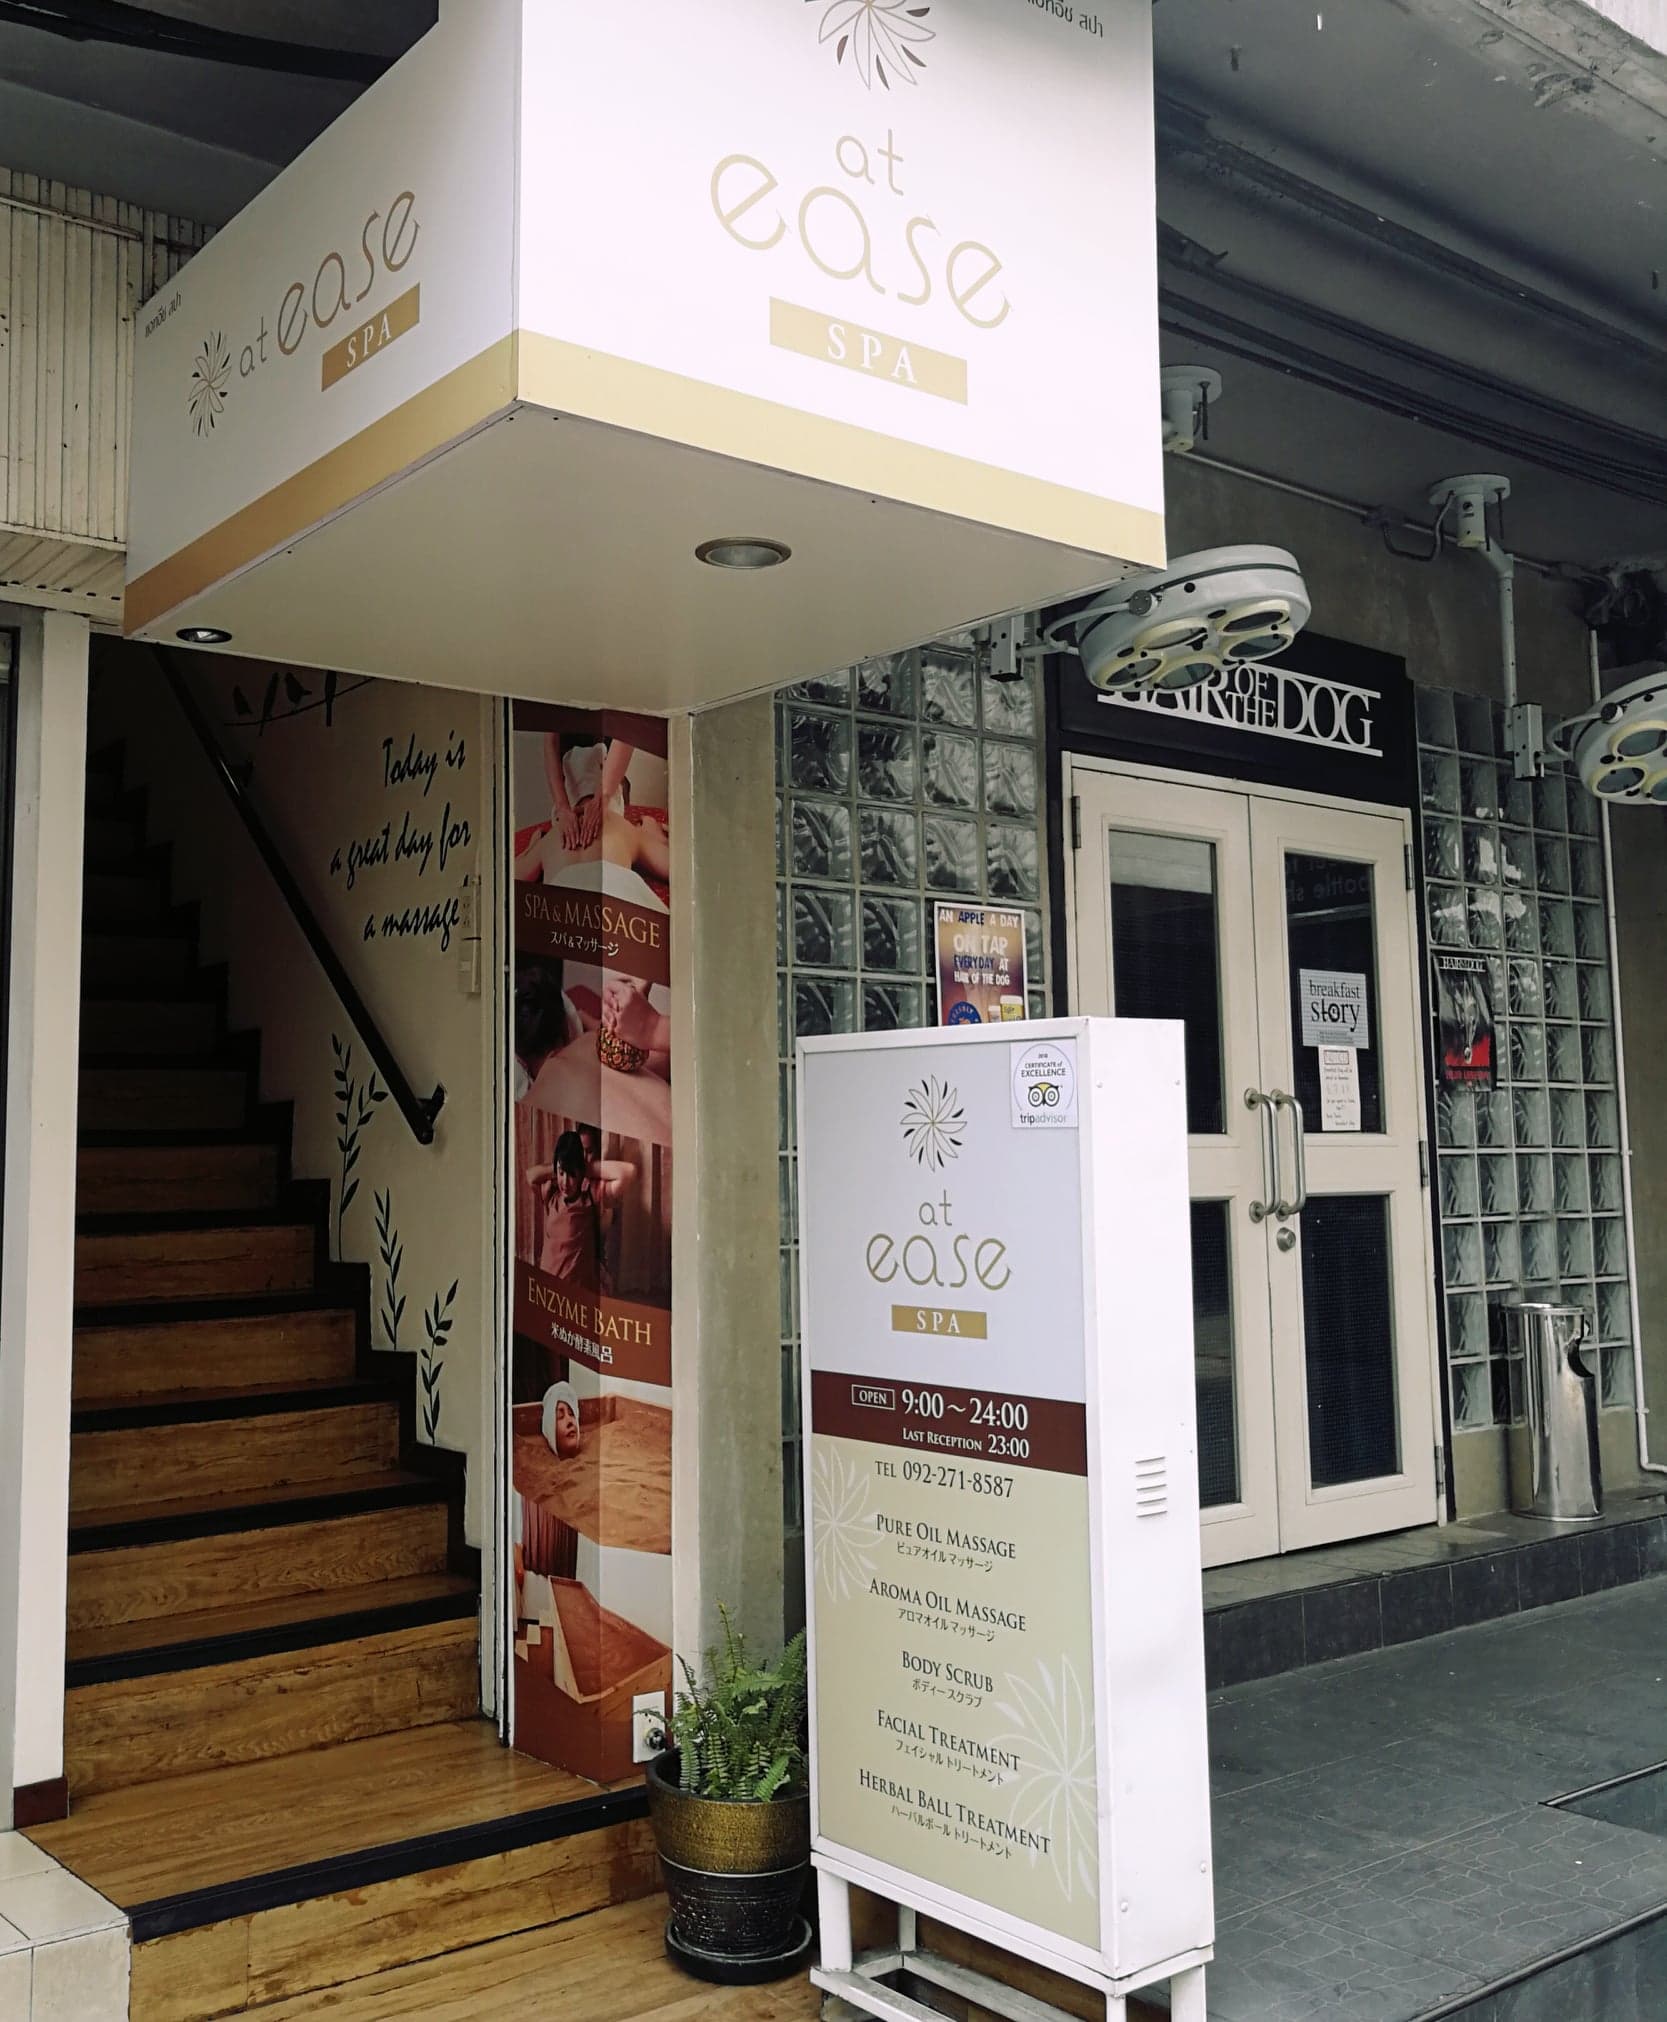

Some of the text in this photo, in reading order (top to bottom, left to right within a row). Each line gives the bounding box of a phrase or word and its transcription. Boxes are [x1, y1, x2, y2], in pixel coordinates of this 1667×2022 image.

[1080, 14, 1103, 38] สปา
[836, 128, 904, 196] at
[711, 154, 1012, 329] ease
[239, 191, 420, 377] at ease
[346, 312, 392, 369] SPA
[827, 322, 917, 384] SPA
[1234, 664, 1269, 696] OF
[1226, 691, 1276, 728] THE
[1277, 674, 1374, 747] DOG
[382, 730, 466, 797] Today is
[330, 802, 471, 890] a great day for
[363, 898, 460, 952] a massage
[524, 893, 550, 921] SPA
[564, 901, 661, 949] MASSAGE
[939, 909, 1019, 928] AN APPLE A DAY
[953, 934, 1008, 955] ON TAP
[999, 958, 1009, 971] AT
[971, 972, 979, 984] OF
[995, 974, 1010, 986] DOG
[1309, 979, 1360, 999] breakfast
[1311, 998, 1360, 1032] story
[1021, 1068, 1066, 1077] EXCELLENCE
[1020, 1112, 1066, 1126] tripadvisor
[918, 1189, 952, 1226] at
[866, 1233, 1013, 1291] ease
[528, 1277, 652, 1345] ENZYME BATH
[916, 1310, 960, 1334] SPA
[858, 1390, 888, 1405] OPEN
[902, 1427, 1030, 1458] LAST RECEPTION 23:00
[875, 1460, 1014, 1498] TEL 092-271-8587
[876, 1514, 1017, 1559] PURE OIL MASSAGE
[869, 1578, 1027, 1631] AROMA OIL MASSAGE
[902, 1651, 994, 1692] BODY SCRUB
[878, 1709, 1021, 1771] FACIAL TREATMENT
[859, 1768, 1051, 1854] HERBAL BALL TREATMENT
